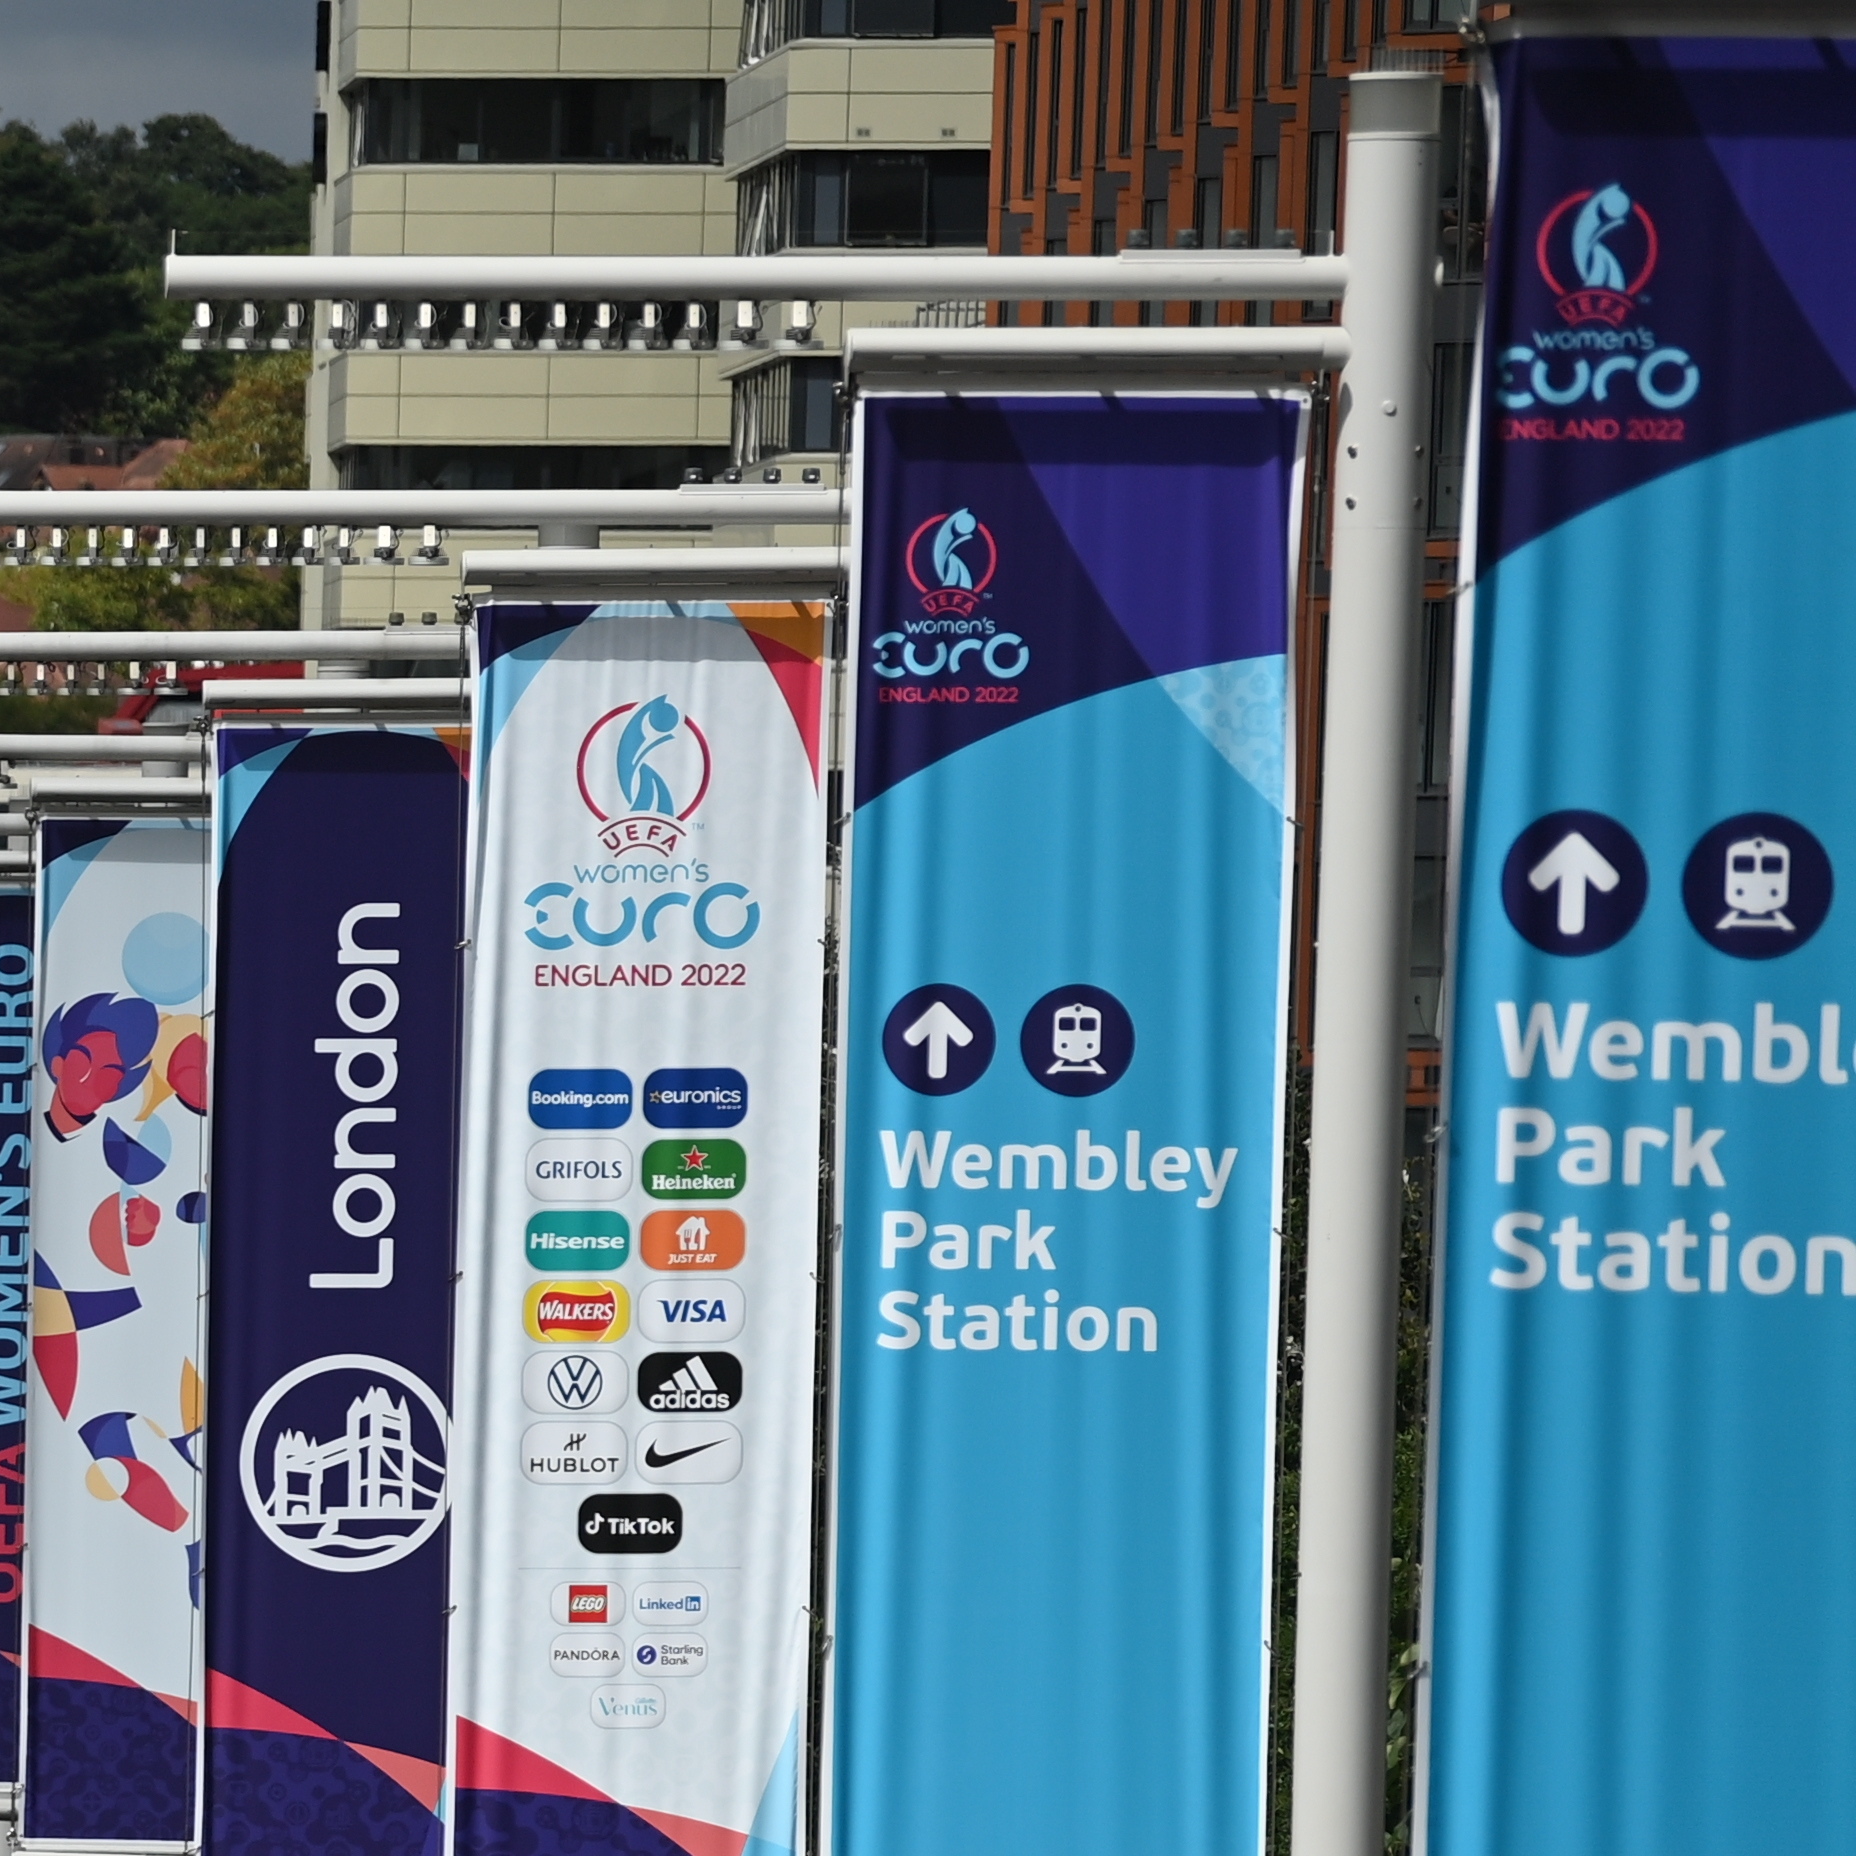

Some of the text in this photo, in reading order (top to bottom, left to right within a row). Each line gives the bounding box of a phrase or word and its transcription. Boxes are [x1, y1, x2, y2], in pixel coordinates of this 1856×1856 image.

[923, 595, 973, 613] UEFA
[905, 617, 995, 634] women's
[879, 686, 1019, 702] ENGLAND 2022
[603, 824, 678, 851] UEFA
[574, 858, 709, 884] women's
[535, 963, 746, 987] ENGLAND 2022
[1496, 1001, 1856, 1085] Wembl
[309, 902, 401, 1289] London
[532, 1091, 629, 1107] Booking.com
[661, 1086, 741, 1103] euronics
[1495, 1107, 1726, 1187] Park
[536, 1161, 622, 1179] GRIFOLS
[880, 1129, 1238, 1209] Wembley
[652, 1174, 736, 1190] Heineken
[530, 1233, 625, 1250] Hisense
[881, 1209, 1056, 1270] Park
[668, 1254, 717, 1264] JUST EAT
[1491, 1211, 1856, 1296] Station
[539, 1300, 614, 1321] WALKERS
[657, 1300, 727, 1322] VISA
[877, 1289, 1157, 1352] Station
[650, 1388, 730, 1410] adidas
[531, 1458, 619, 1473] HUBLOT
[608, 1517, 675, 1535] TikTok
[571, 1595, 605, 1612] LEGO
[661, 1645, 703, 1657] Starling
[661, 1655, 689, 1666] Bank
[598, 1697, 657, 1717] Venus
